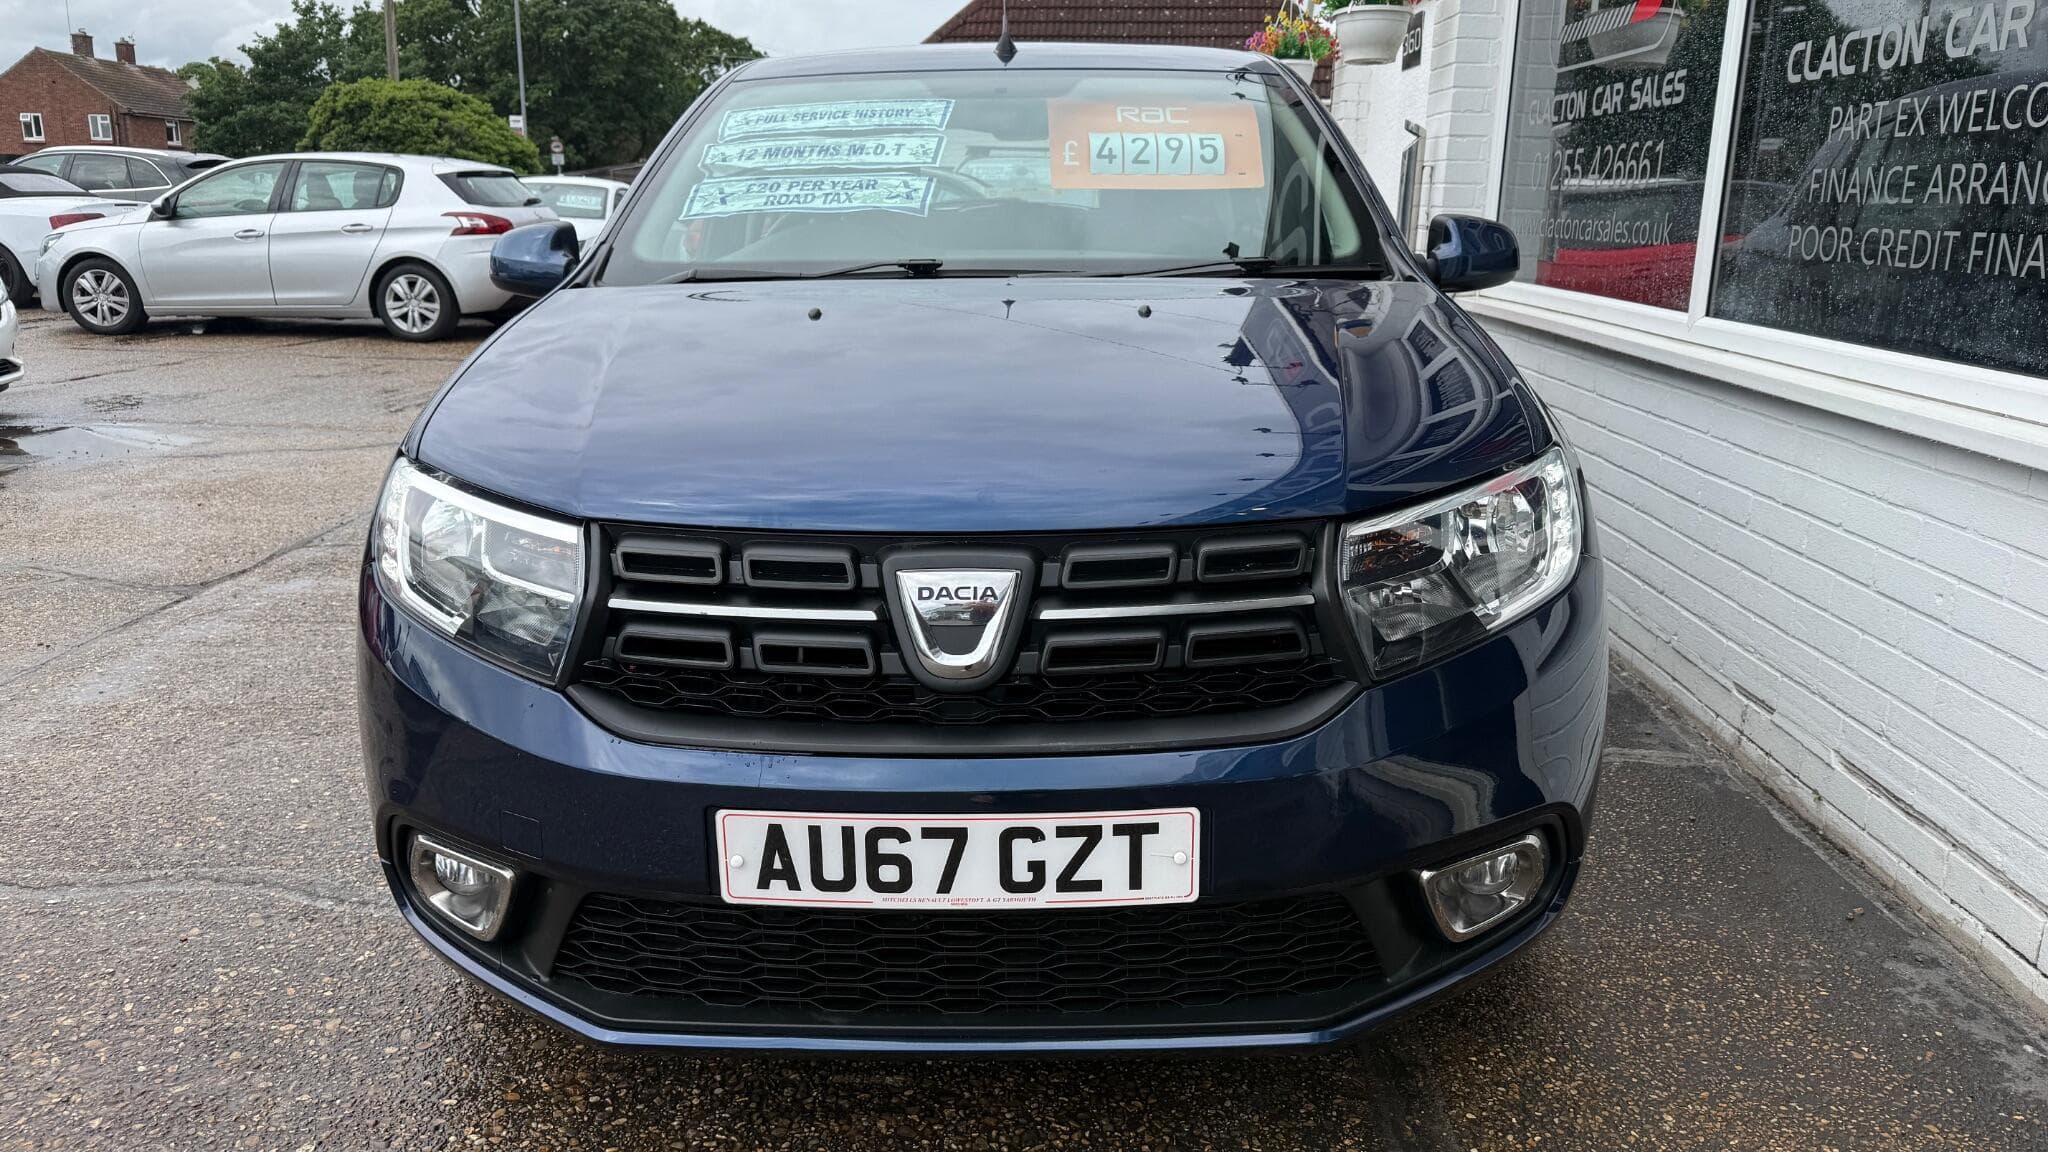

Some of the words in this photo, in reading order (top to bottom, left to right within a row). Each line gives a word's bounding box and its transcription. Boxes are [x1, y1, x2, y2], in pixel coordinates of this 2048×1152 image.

[1787, 16, 1929, 84] CLACTON
[1945, 0, 2037, 58] CAR
[755, 113, 787, 124] FULL
[791, 110, 843, 122] SERVICE
[855, 108, 914, 119] HISTORY
[1529, 89, 1588, 126] CLACTON
[1592, 82, 1624, 117] CAR
[1629, 69, 1688, 111] SALES
[1827, 100, 1890, 142] PART
[1894, 95, 1931, 138] EX
[737, 148, 753, 162] 12
[762, 144, 841, 160] MONTHS
[1096, 137, 1219, 165] 4295
[1531, 147, 1585, 192] 01255
[1588, 139, 1665, 189] 426661
[744, 182, 781, 194] £20
[787, 180, 824, 191] PER
[830, 179, 879, 190] YEAR
[763, 194, 816, 206] ROAD
[822, 192, 855, 204] TAX
[1808, 165, 1919, 205] FINANCE
[1922, 160, 2048, 205] ARRAN
[1788, 225, 1853, 263] POOR
[1860, 227, 1961, 271] CREDIT
[1967, 231, 2046, 280] FINA
[917, 586, 999, 601] DACIA
[756, 823, 969, 894] AU67
[999, 822, 1160, 894] GZT
